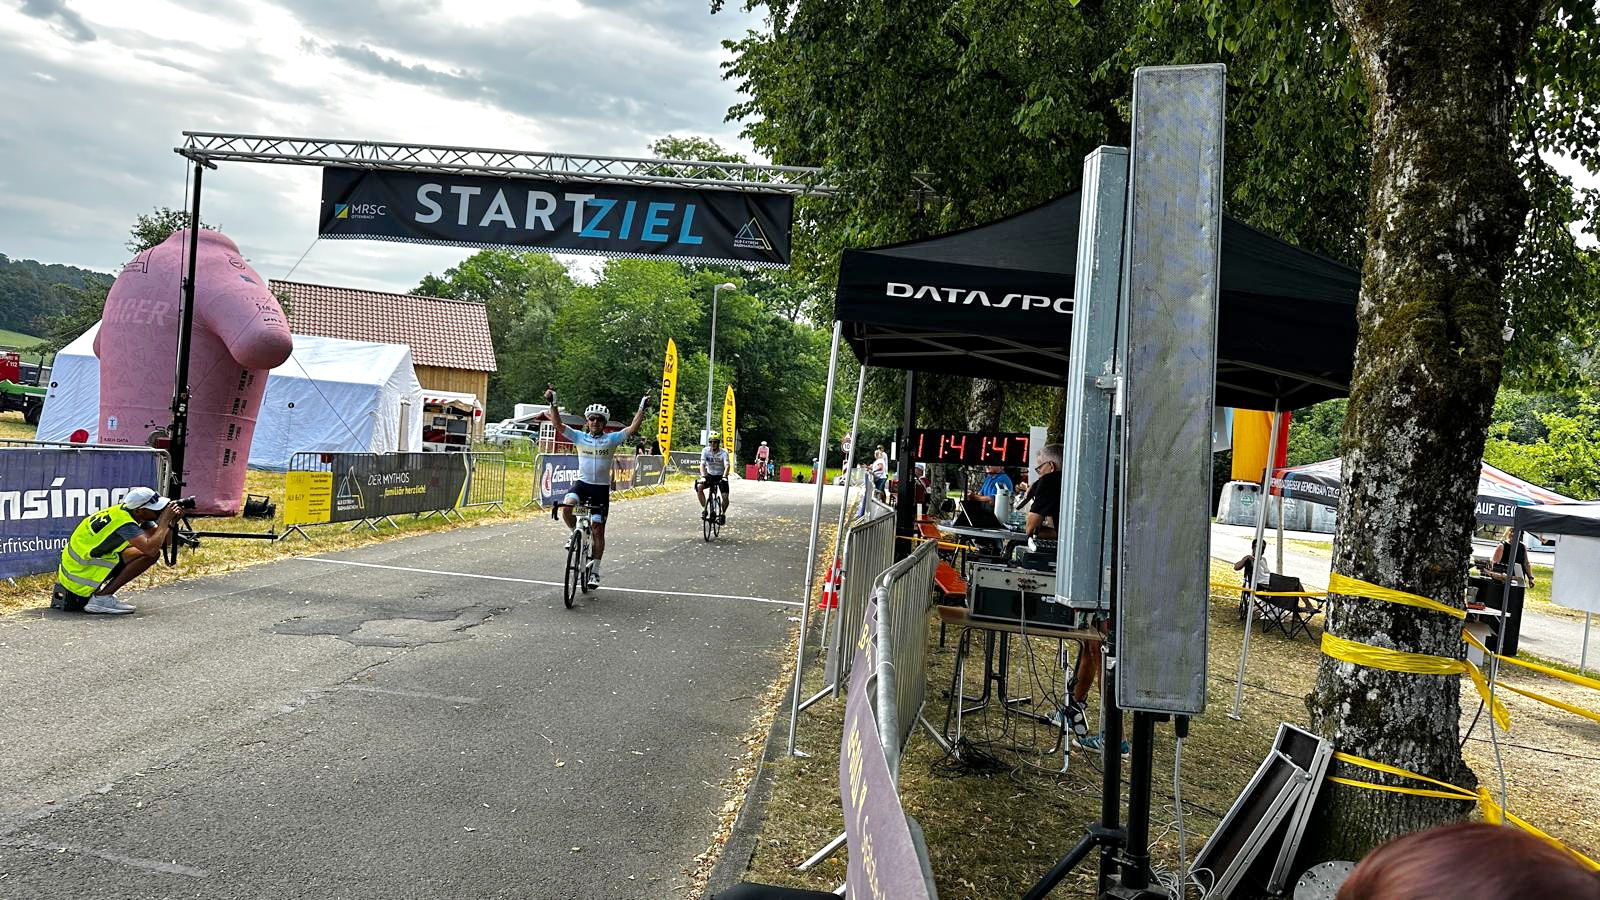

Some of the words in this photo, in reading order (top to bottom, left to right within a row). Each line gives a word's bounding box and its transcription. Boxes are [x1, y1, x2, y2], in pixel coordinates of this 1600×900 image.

[351, 203, 387, 216] MRSC
[415, 183, 595, 233] START
[579, 198, 704, 244] ZIEL
[367, 473, 382, 486] DER
[382, 472, 410, 485] MYTHOS
[1474, 501, 1496, 515] AUF
